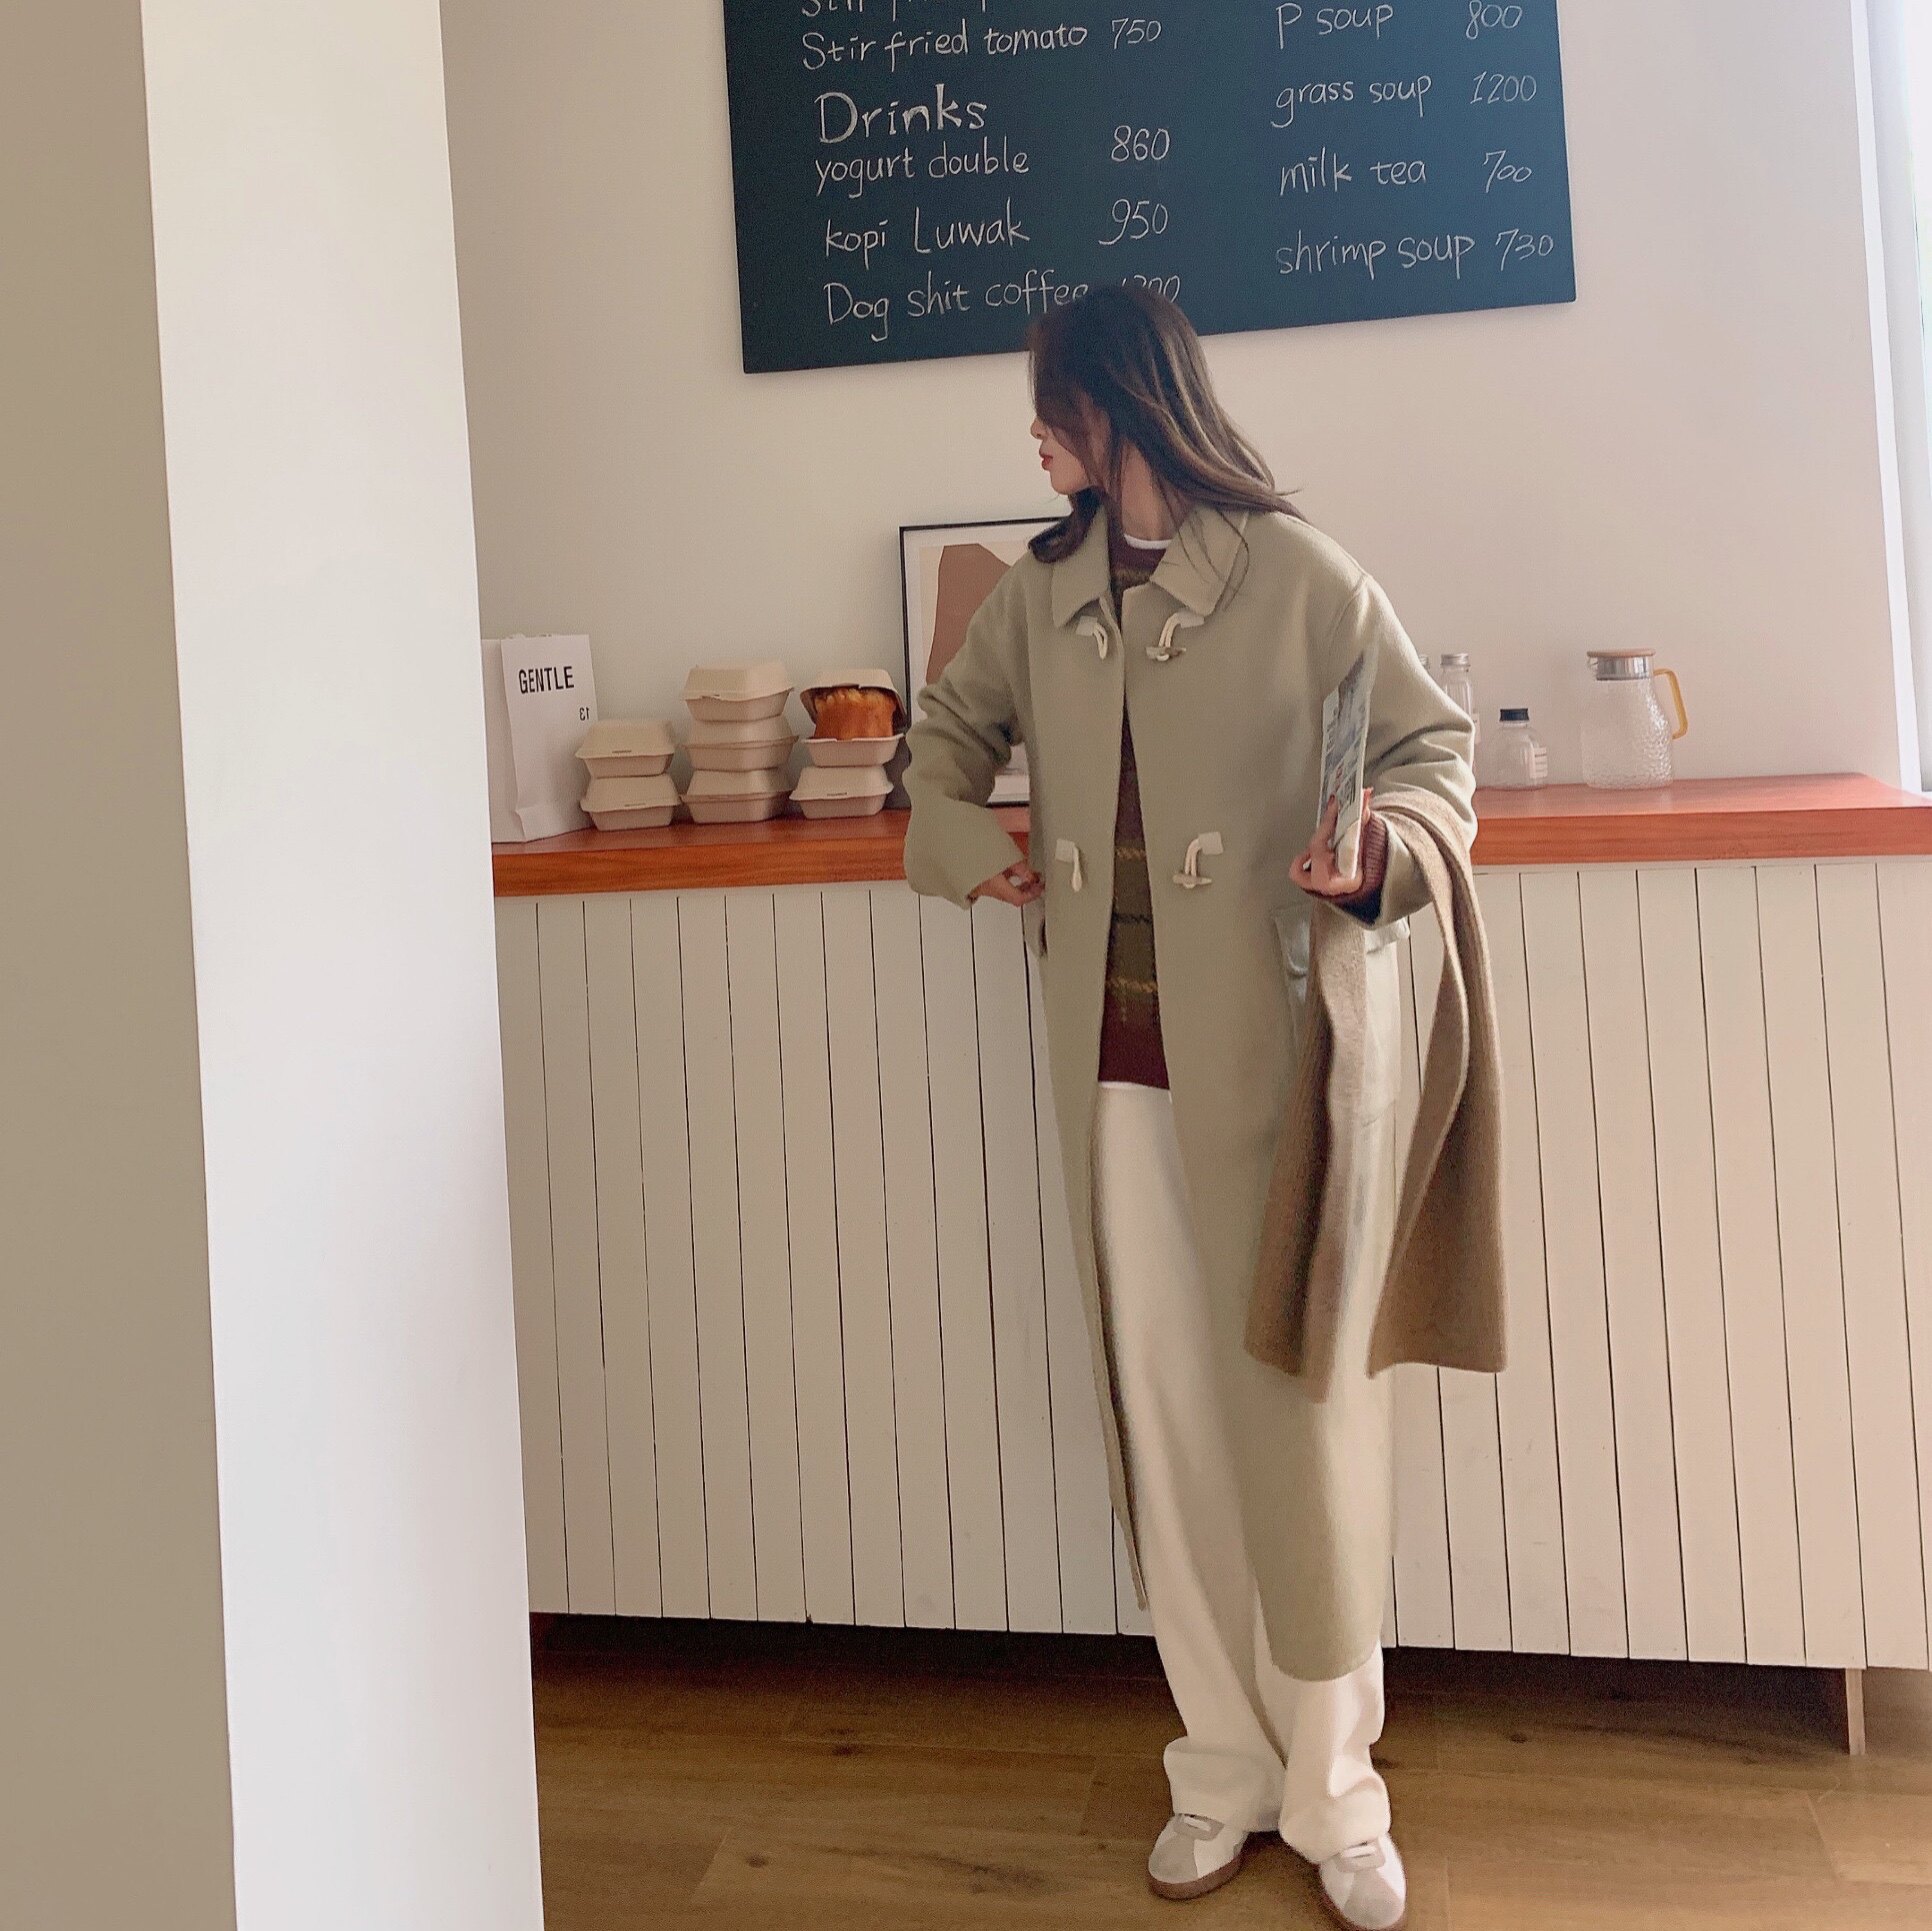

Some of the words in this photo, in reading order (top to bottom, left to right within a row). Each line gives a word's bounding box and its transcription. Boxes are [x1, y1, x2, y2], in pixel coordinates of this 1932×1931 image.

[802, 32, 876, 70] Stir
[884, 18, 968, 72] fried
[984, 24, 1087, 55] tomato
[1112, 18, 1161, 49] 750
[1317, 4, 1393, 39] soup
[1466, 0, 1522, 39] 800
[814, 83, 987, 143] Drinks
[1271, 81, 1353, 128] grass
[1369, 75, 1431, 117] soup
[1471, 72, 1536, 104] 1200
[815, 149, 916, 199] yogurt
[929, 136, 1029, 178] double
[1111, 125, 1170, 162] 860
[1280, 147, 1352, 196] milk
[1370, 161, 1426, 184] tea
[1484, 150, 1532, 192] 700
[826, 219, 888, 270] kopi
[914, 197, 1030, 253] Luwak
[1099, 199, 1168, 245] 950
[1277, 230, 1386, 280] shrimp
[1398, 235, 1475, 279] soup
[1496, 229, 1553, 270] 730
[824, 282, 889, 342] Dog
[908, 271, 969, 317] shit
[518, 666, 575, 694] GENTLE
